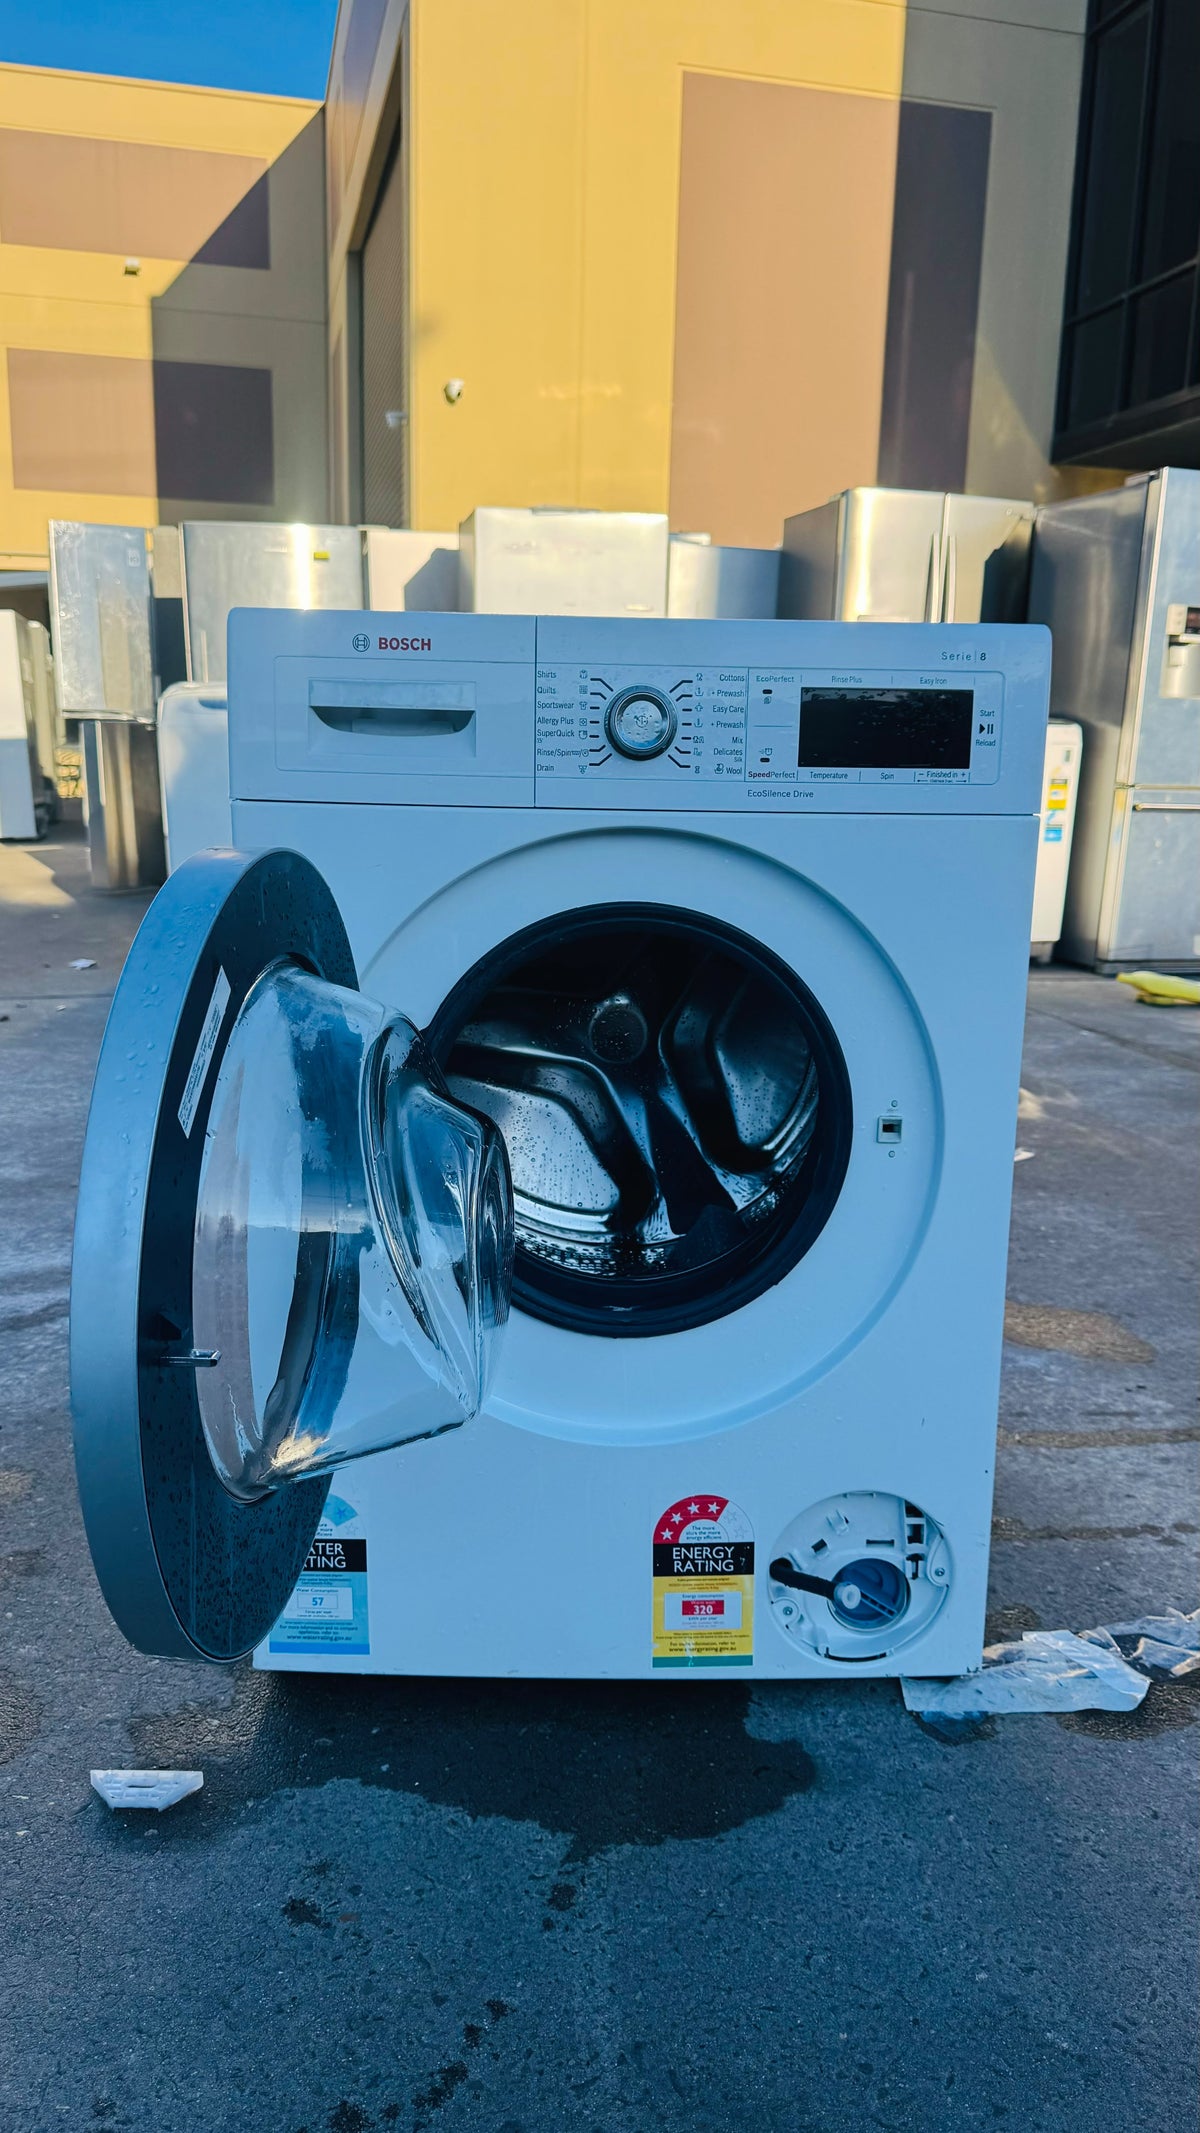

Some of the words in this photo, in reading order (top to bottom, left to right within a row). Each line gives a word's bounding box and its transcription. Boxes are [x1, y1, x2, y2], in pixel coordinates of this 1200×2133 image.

[378, 636, 432, 651] BOSCH
[941, 651, 972, 662] Serie
[979, 652, 987, 661] 8
[536, 669, 557, 679] Shirts
[719, 673, 745, 682] Cottons
[756, 675, 795, 683] EcoPerfect
[831, 676, 848, 684] Rinse
[849, 676, 862, 684] Plus
[919, 676, 934, 686] Easy
[935, 677, 947, 685] Iron
[536, 685, 557, 695] Quilts
[716, 689, 745, 698] Prewash
[536, 700, 575, 710] Sportswear
[712, 705, 728, 714] Easy
[728, 705, 745, 714] Care
[979, 709, 995, 717] Start
[536, 716, 560, 726] Allergy
[560, 716, 575, 725] Plus
[716, 720, 744, 729] Prewash
[536, 729, 575, 738] SuperQuick
[731, 736, 743, 744] Mix
[975, 739, 996, 747] Reload
[536, 748, 572, 758] Rinse/Spin
[713, 748, 743, 756] Delicates
[536, 763, 555, 772] Drain
[725, 766, 743, 775] Wool
[747, 770, 796, 780] SpeedPerfect
[809, 771, 848, 781] Temperature
[880, 772, 895, 781] Spin
[926, 770, 951, 779] Finished
[747, 789, 791, 798] EcoSilence
[793, 789, 814, 799] Drive
[672, 1546, 735, 1560] ENERGY
[673, 1559, 734, 1573] RATING
[311, 1596, 325, 1607] 57
[693, 1605, 714, 1615] 320
